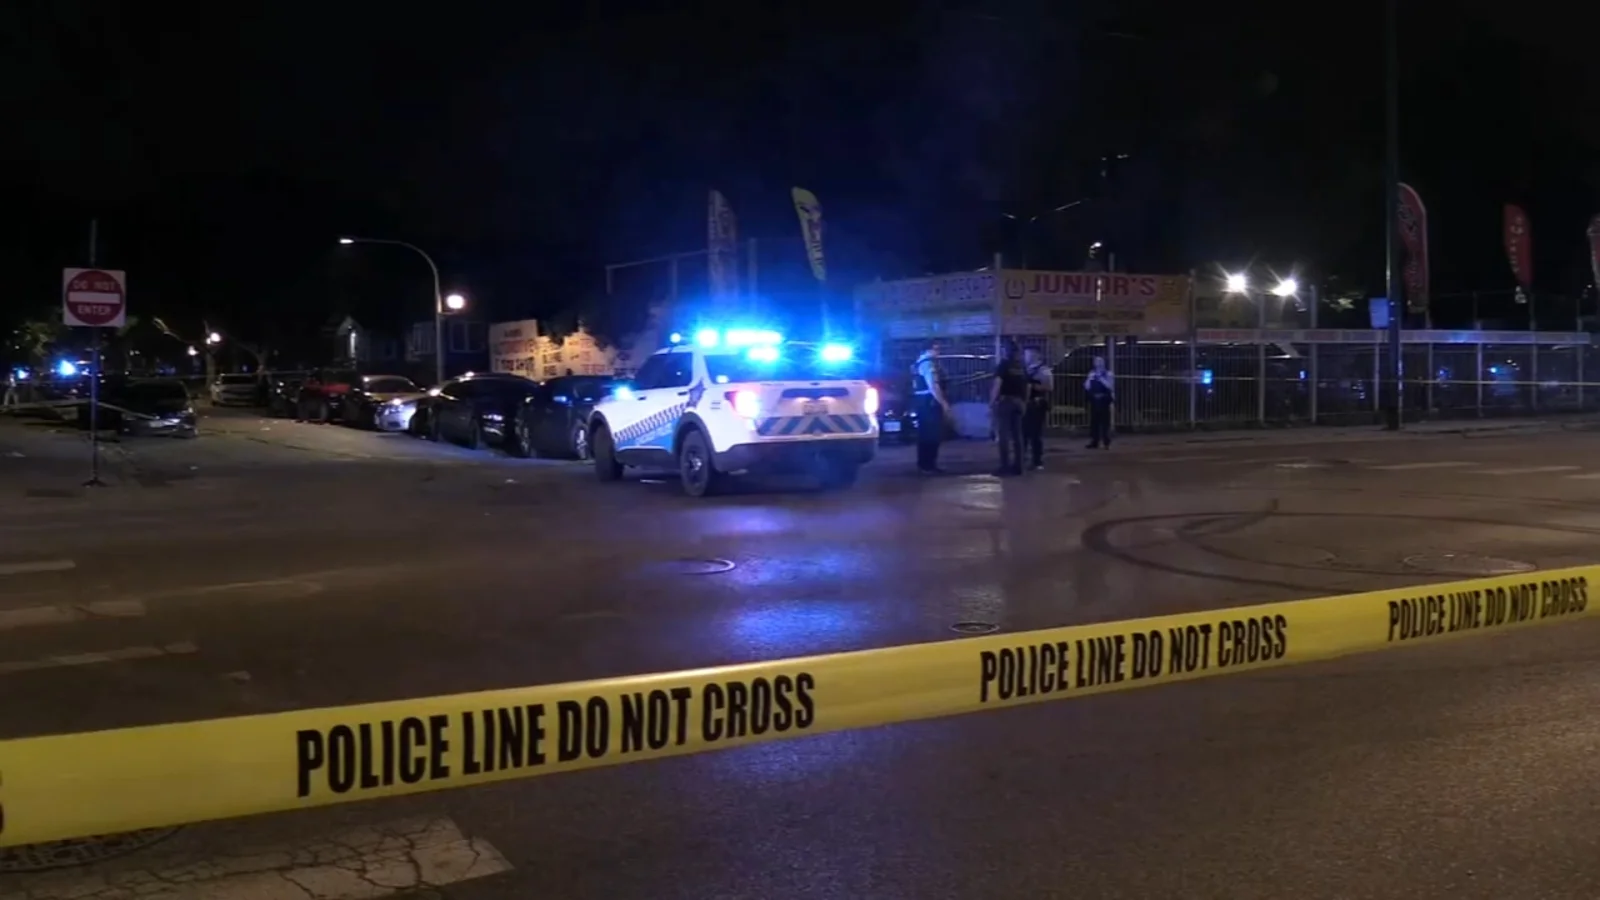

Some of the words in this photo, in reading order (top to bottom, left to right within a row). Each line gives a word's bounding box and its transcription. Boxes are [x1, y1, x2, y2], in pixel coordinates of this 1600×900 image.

[72, 280, 88, 290] DO
[93, 281, 116, 291] NOT
[1030, 274, 1155, 296] JUNIOR'S
[77, 304, 111, 315] ENTER
[1387, 595, 1445, 642] POLICE
[1447, 590, 1481, 632] LINE
[1484, 587, 1506, 627] DO
[1507, 583, 1538, 623] NOT
[1539, 576, 1588, 619] CROSS
[980, 641, 1069, 702] POLICE
[1075, 634, 1126, 688] LINE
[1131, 629, 1164, 680] DO
[1169, 623, 1212, 674] NOT
[1218, 614, 1287, 667] CROSS
[296, 714, 450, 798] POLICE
[462, 704, 546, 775] LINE
[557, 696, 609, 762] DO
[620, 687, 692, 753] NOT
[702, 672, 814, 742] CROSS
